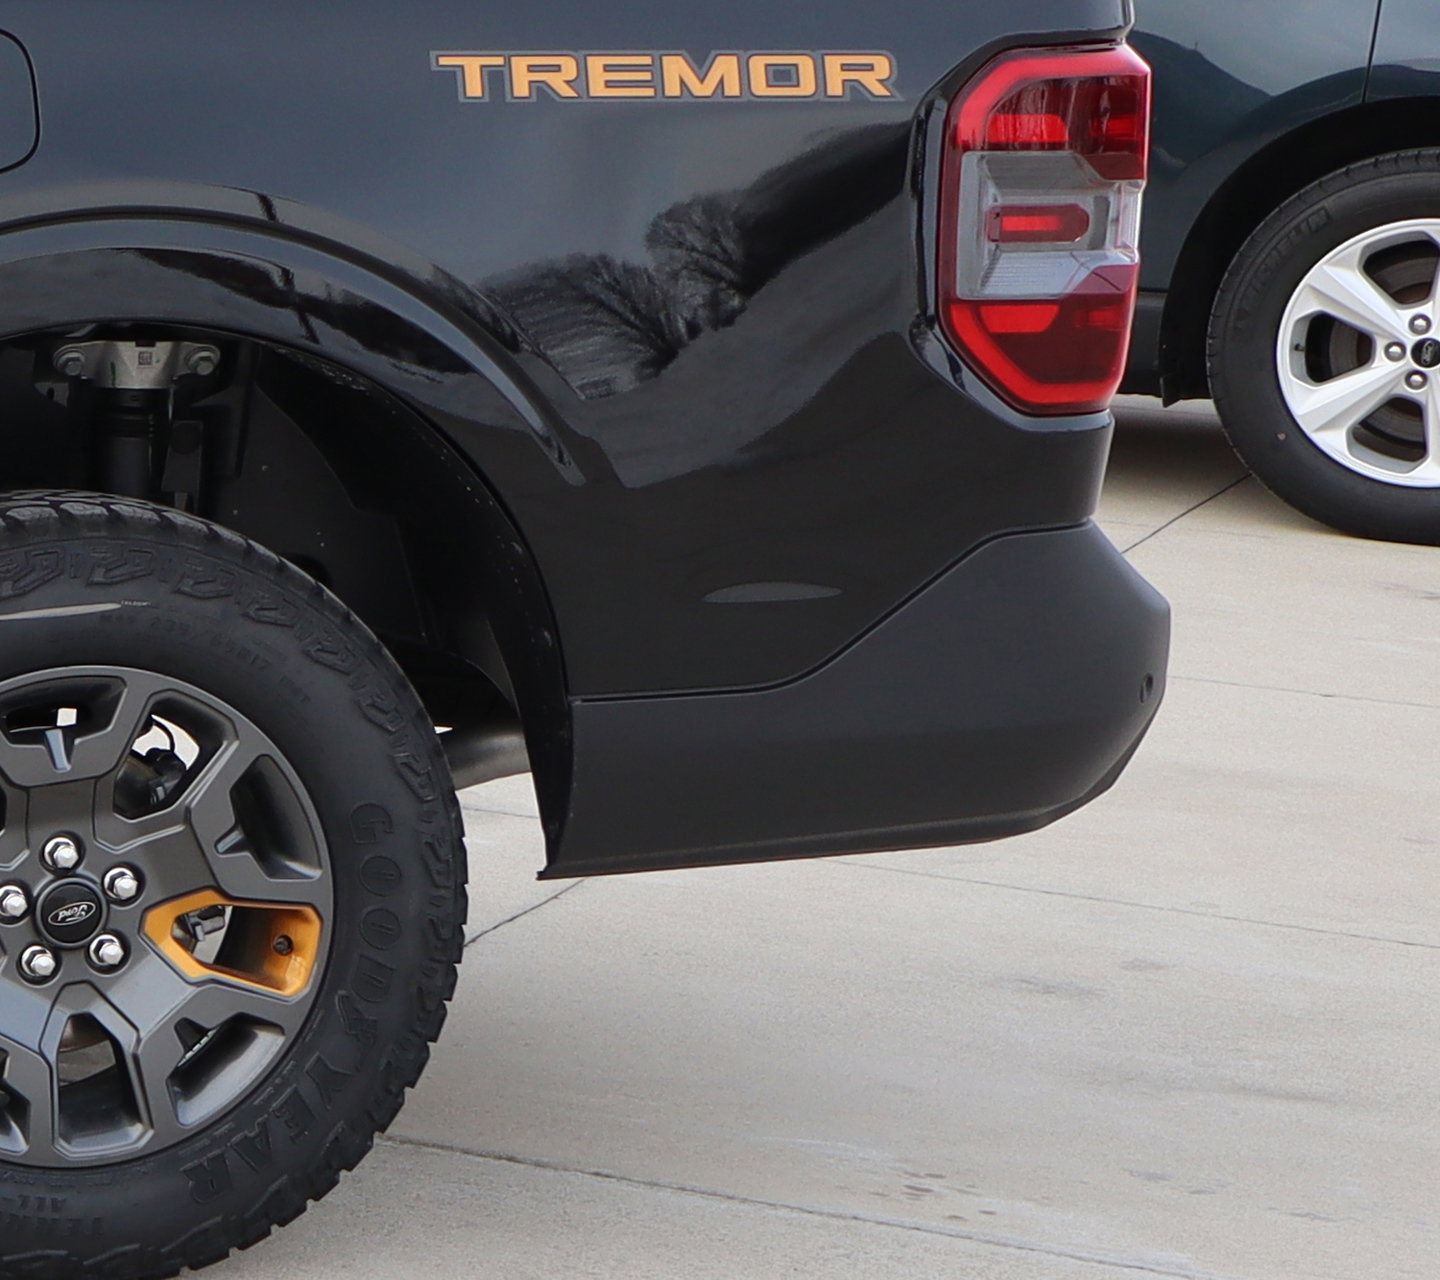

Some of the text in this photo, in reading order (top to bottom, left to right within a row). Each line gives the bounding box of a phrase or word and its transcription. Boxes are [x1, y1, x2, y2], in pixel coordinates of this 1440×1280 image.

[436, 53, 895, 100] TREMOR
[56, 904, 88, 922] Ford
[181, 801, 402, 1205] GOODYEAR
